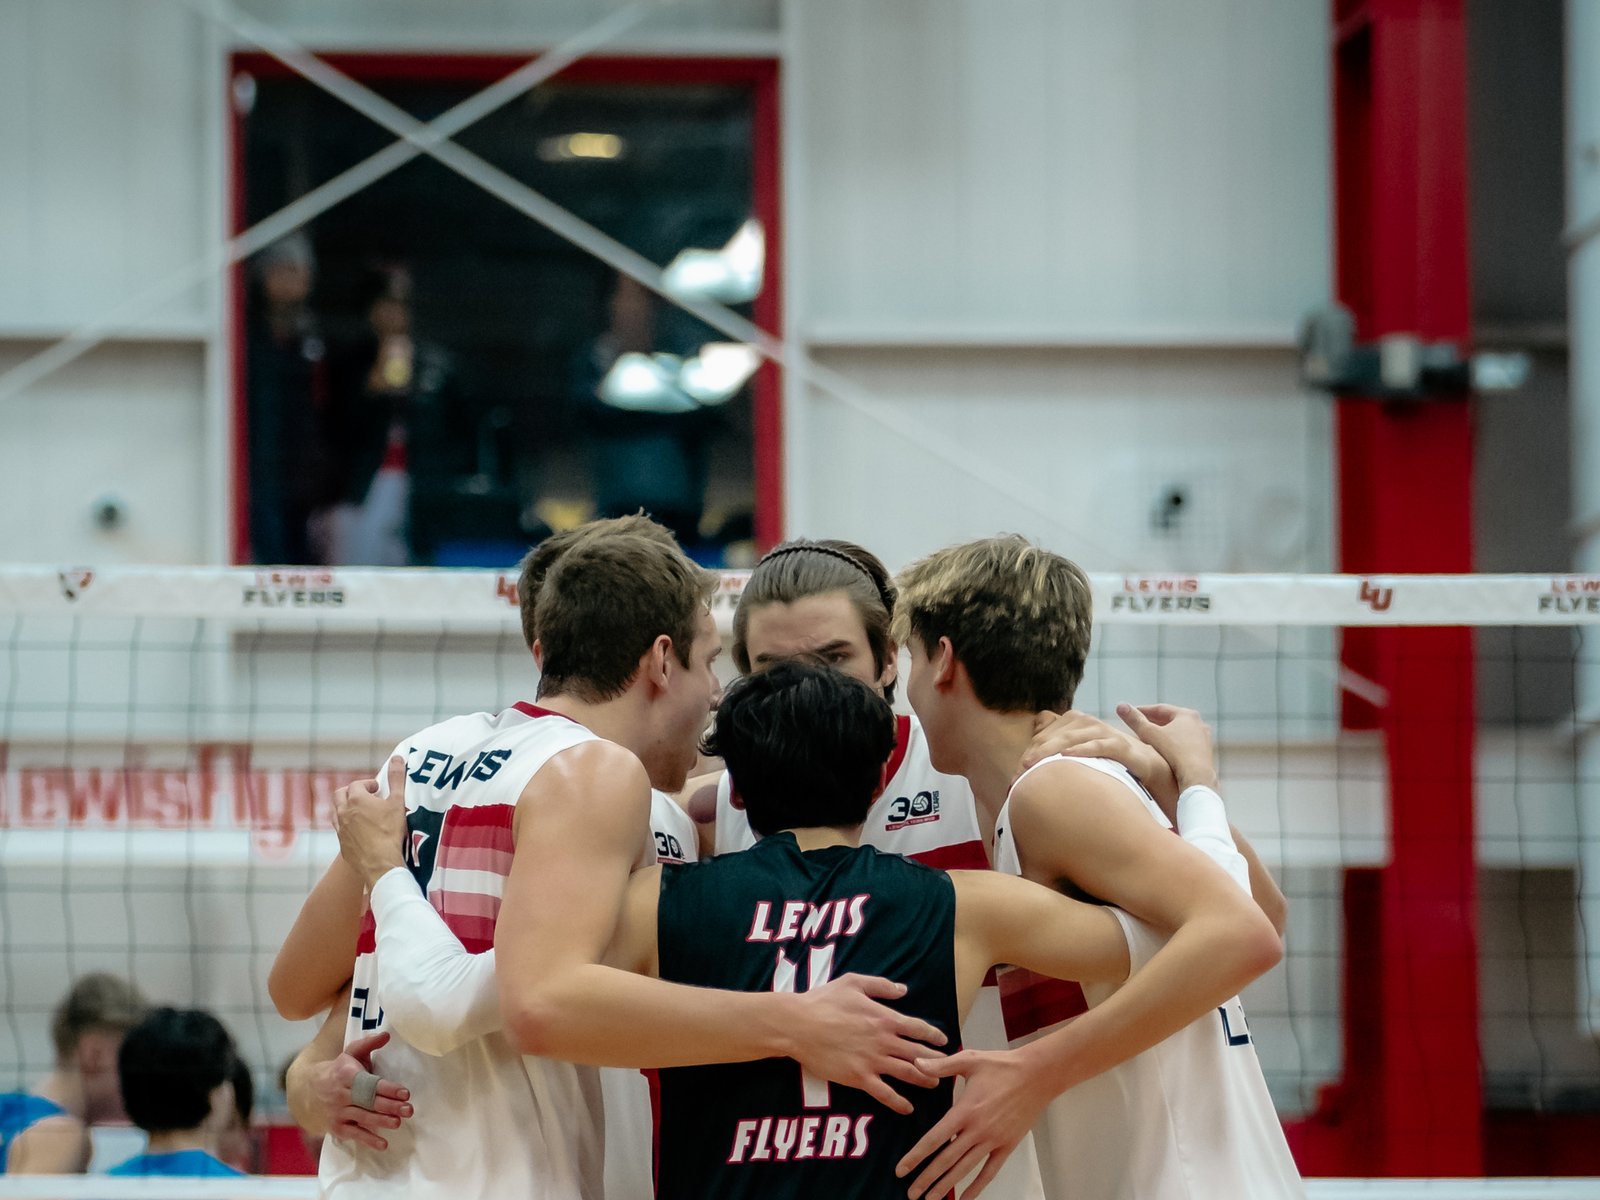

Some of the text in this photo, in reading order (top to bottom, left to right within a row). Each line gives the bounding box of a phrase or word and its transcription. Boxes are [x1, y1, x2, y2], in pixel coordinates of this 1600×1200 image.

[1123, 577, 1198, 593] LEWIS
[1110, 595, 1211, 613] FLYERS
[887, 791, 933, 822] 30
[655, 831, 683, 859] 30
[745, 893, 870, 942] LEWIS
[726, 1113, 874, 1164] FLYERS
